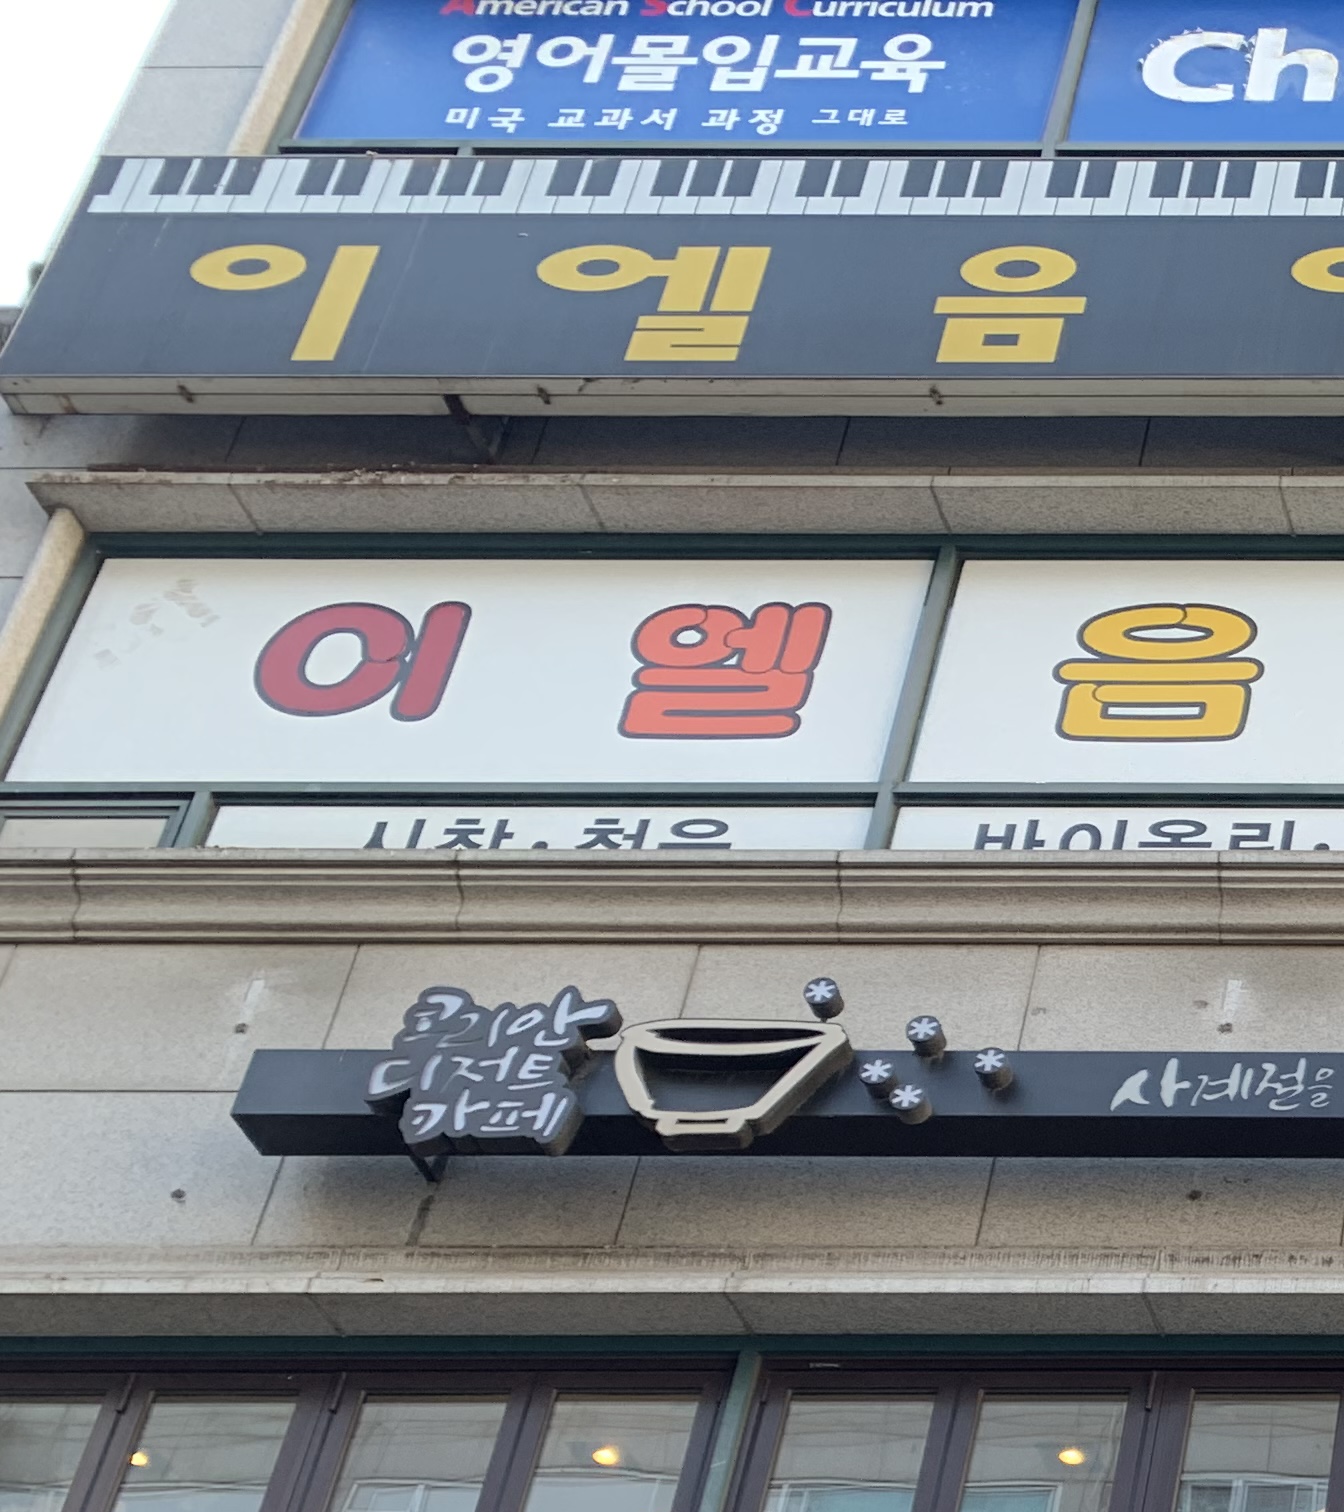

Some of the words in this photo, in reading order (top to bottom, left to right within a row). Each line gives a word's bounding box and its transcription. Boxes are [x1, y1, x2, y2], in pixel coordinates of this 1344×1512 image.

[452, 33, 946, 94] 영어몰입교육
[445, 108, 525, 131] 미국
[547, 108, 678, 132] 교과서
[701, 108, 784, 134] 과정
[811, 108, 909, 127] 그대로
[403, 992, 610, 1048] 코리안
[368, 1045, 555, 1096] 디저트
[1110, 1057, 1334, 1113] 사계절을
[411, 1089, 568, 1136] 카페
